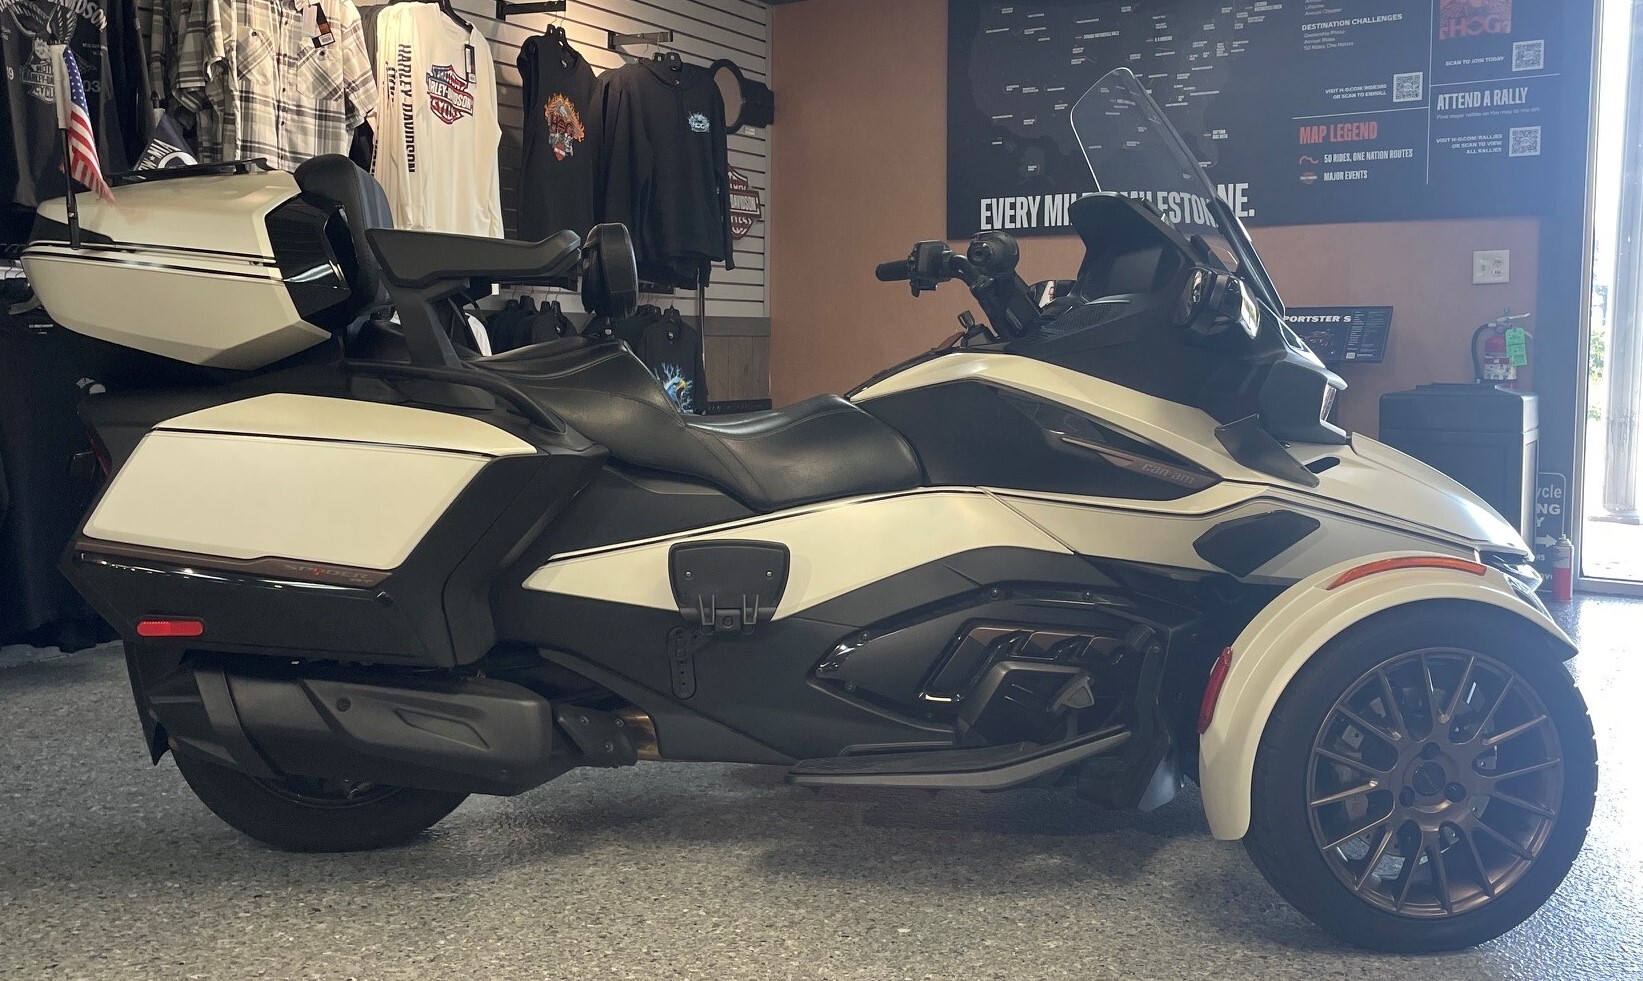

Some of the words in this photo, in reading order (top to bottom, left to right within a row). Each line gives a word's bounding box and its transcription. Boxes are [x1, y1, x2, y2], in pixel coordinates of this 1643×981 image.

[1301, 19, 1350, 31] DESTINATION
[1351, 13, 1403, 25] CHALLENGES
[1437, 92, 1481, 111] ATTEND
[1483, 90, 1490, 107] A
[1494, 87, 1528, 106] RALLY
[1300, 125, 1327, 144] MAP
[1330, 121, 1378, 142] LEGEND
[1324, 154, 1333, 163] 50
[1333, 153, 1352, 163] RIDES,
[1352, 151, 1365, 161] ONE
[1366, 150, 1389, 160] NATION
[1390, 148, 1413, 158] ROUTES
[1324, 172, 1344, 181] MAJOR
[1345, 170, 1368, 179] EVENTS
[980, 195, 1041, 230] EVERY
[1283, 315, 1341, 323] PORTSTER
[1343, 315, 1352, 323] S
[1141, 463, 1195, 485] can-am
